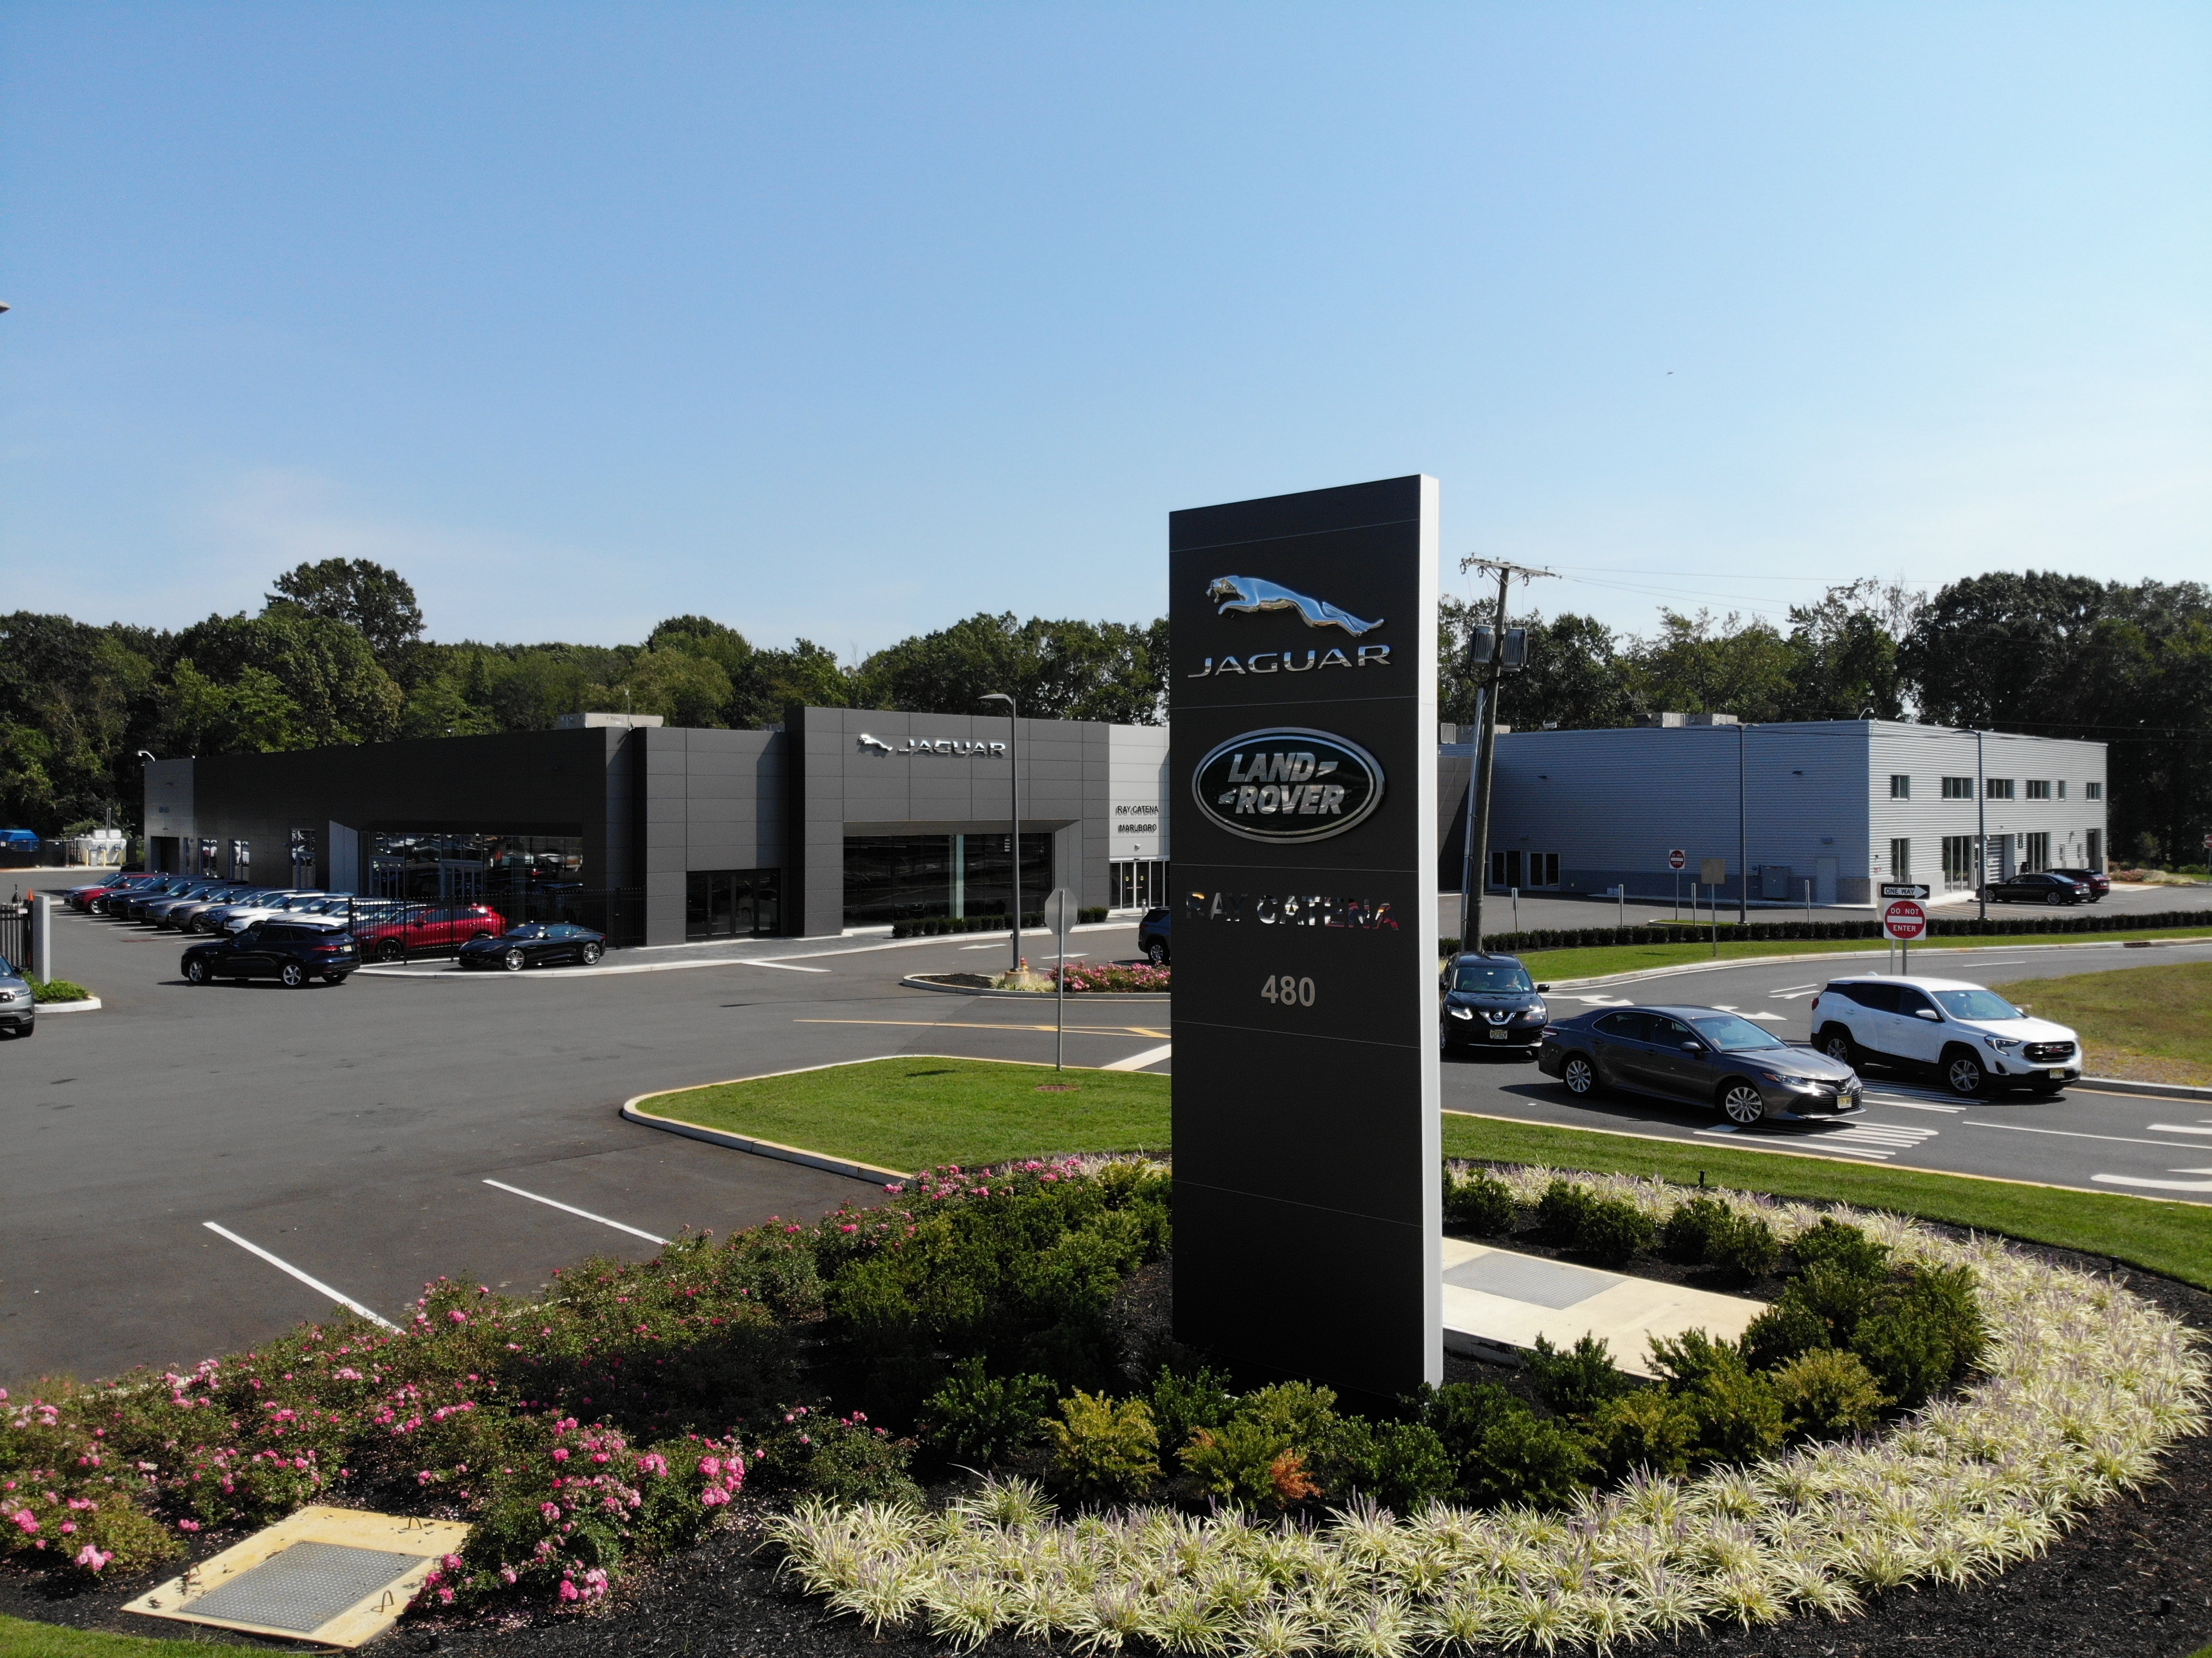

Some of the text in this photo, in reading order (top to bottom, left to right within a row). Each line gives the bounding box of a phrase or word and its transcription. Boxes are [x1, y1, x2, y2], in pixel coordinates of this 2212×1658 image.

[1188, 645, 1391, 678] JAGUAR
[899, 739, 1006, 755] JAGUAR
[1227, 752, 1316, 782] LAND
[1117, 805, 1159, 813] RAY CATENA
[1235, 784, 1345, 814] ROVER
[1119, 824, 1157, 832] MARLBORO
[1186, 891, 1399, 931] RAY CATENA
[1261, 975, 1316, 1007] 480
